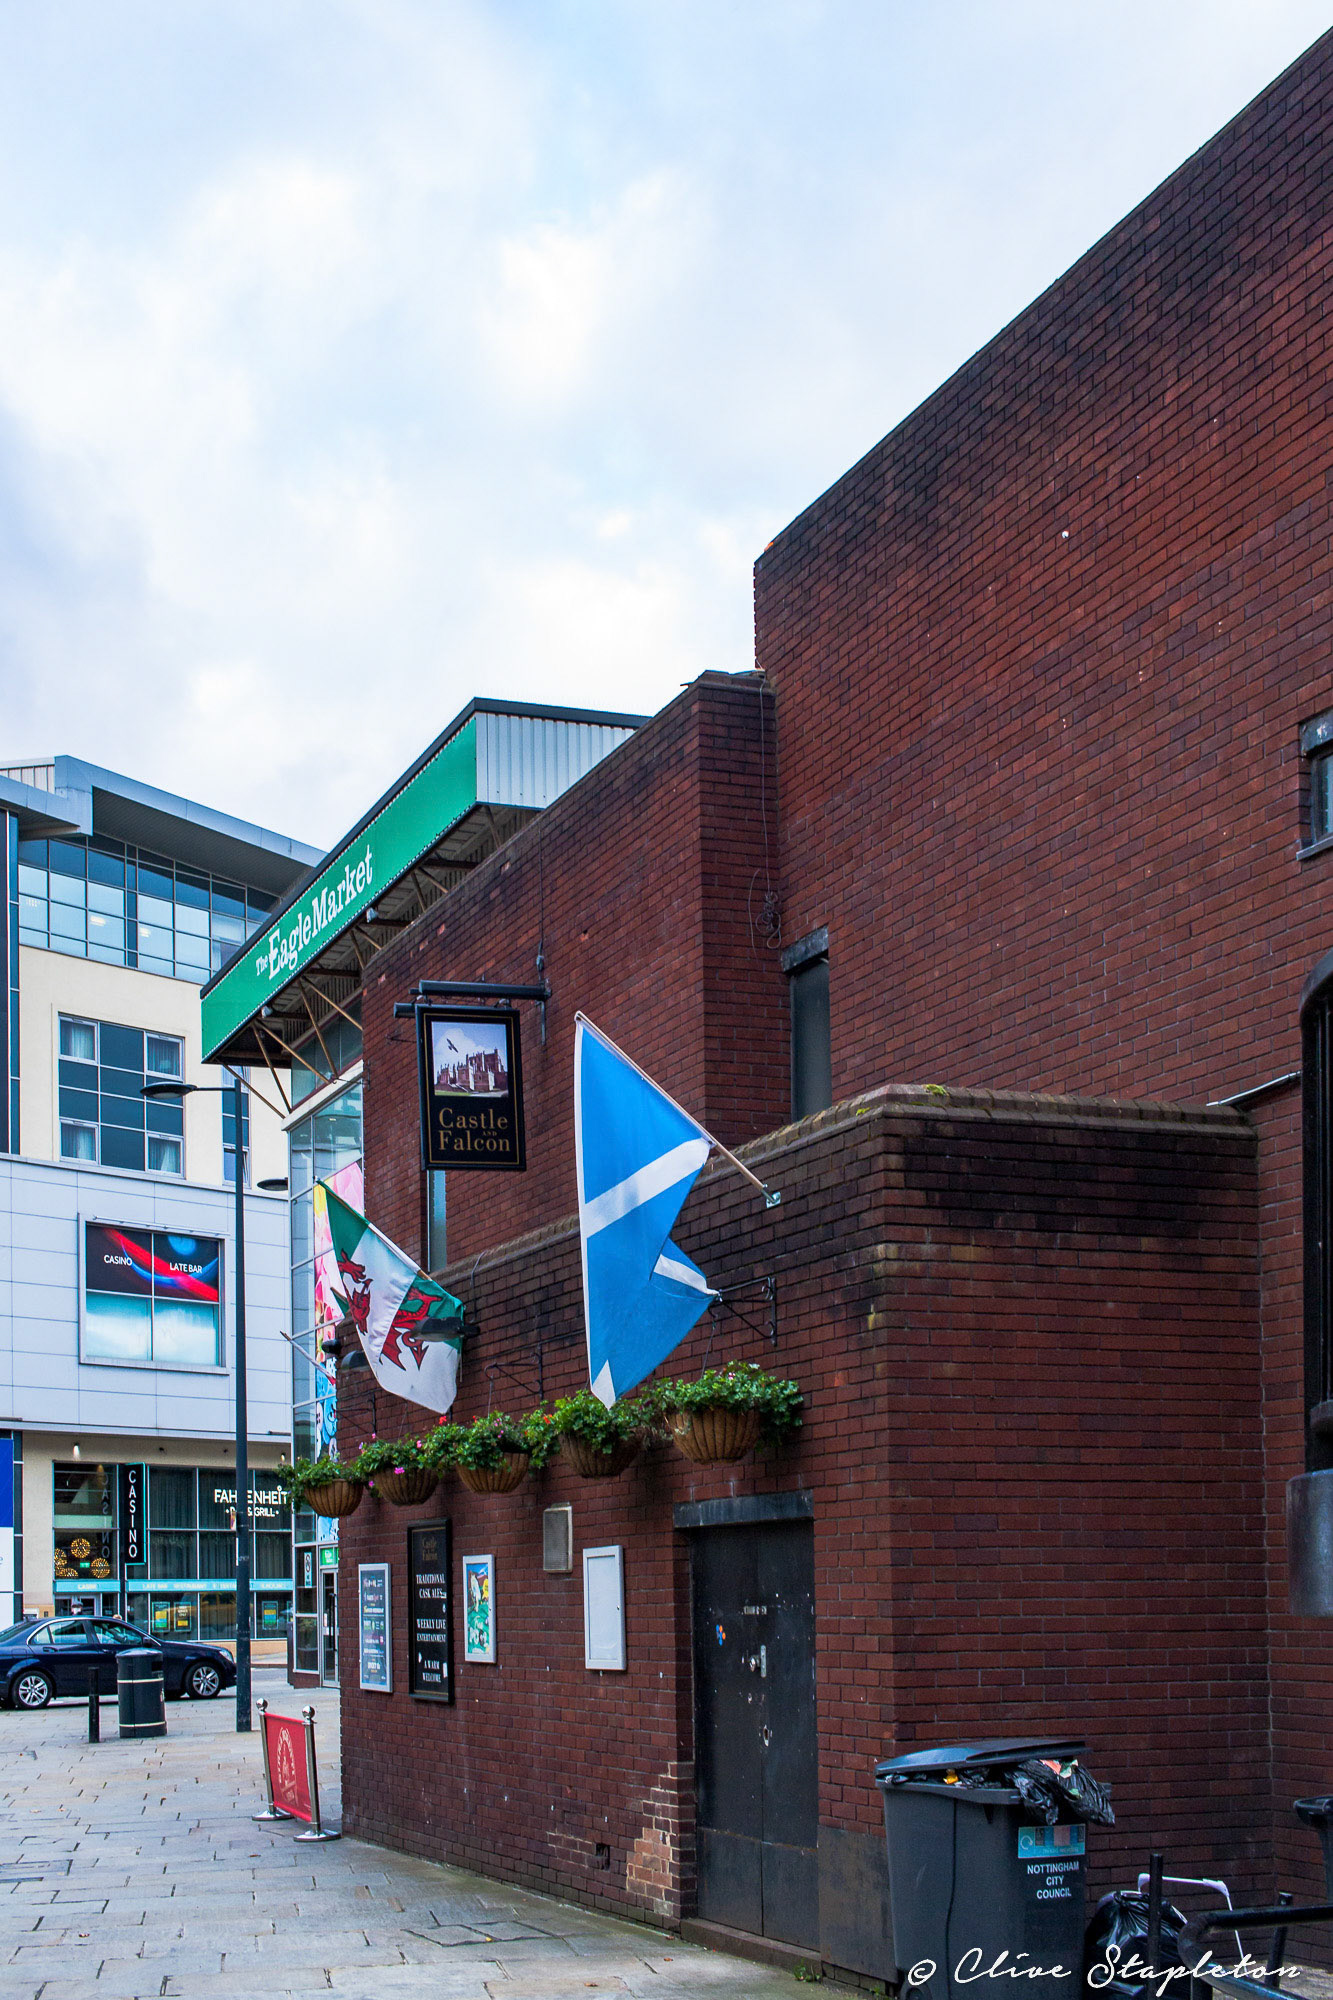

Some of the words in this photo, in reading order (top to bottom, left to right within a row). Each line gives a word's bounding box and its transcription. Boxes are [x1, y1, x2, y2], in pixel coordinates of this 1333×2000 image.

[256, 954, 269, 976] The
[438, 1107, 509, 1130] Castle
[438, 1130, 511, 1152] Falcon
[103, 1254, 133, 1266] CASINO
[169, 1262, 188, 1273] LATE
[188, 1264, 203, 1274] BAR
[214, 1484, 288, 1505] FAHENHEIT
[128, 1470, 138, 1558] CASINO
[254, 1507, 276, 1518] GRILL
[416, 1573, 446, 1585] TRADITIONAL
[419, 1588, 431, 1599] CASK
[432, 1588, 443, 1599] ALES
[416, 1618, 435, 1629] WEEKLY
[435, 1618, 446, 1630] LIVE
[416, 1633, 446, 1643] ENTERTAINMENT
[427, 1660, 440, 1670] WARM
[422, 1672, 442, 1684] WELCOME
[1027, 1861, 1080, 1875] NOTTINGHAM
[1046, 1875, 1065, 1886] CITY
[1036, 1887, 1072, 1900] COUNCIL
